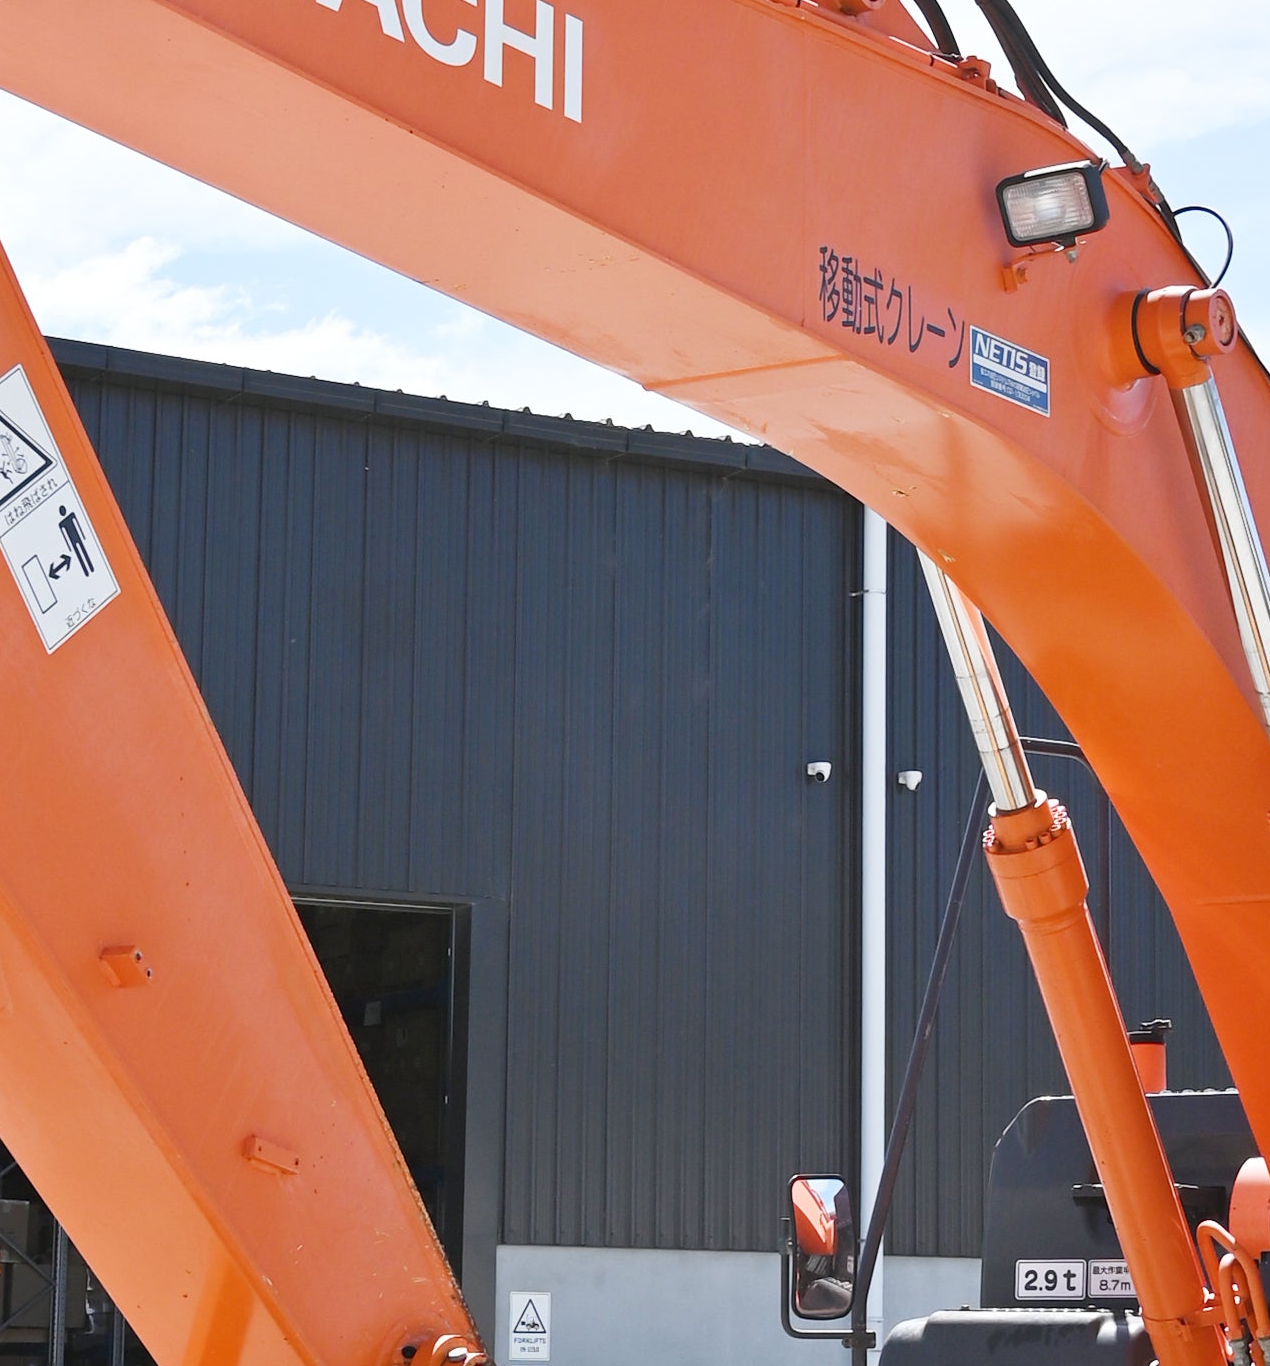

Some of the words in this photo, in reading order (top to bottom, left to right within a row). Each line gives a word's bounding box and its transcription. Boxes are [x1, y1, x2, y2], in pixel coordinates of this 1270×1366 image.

[819, 246, 965, 368] 移動式クレーン
[975, 333, 1029, 375] NETIS
[4, 478, 58, 526] はね飛ばされ
[65, 597, 96, 628] 近づくな
[1099, 1279, 1131, 1291] 8.7m
